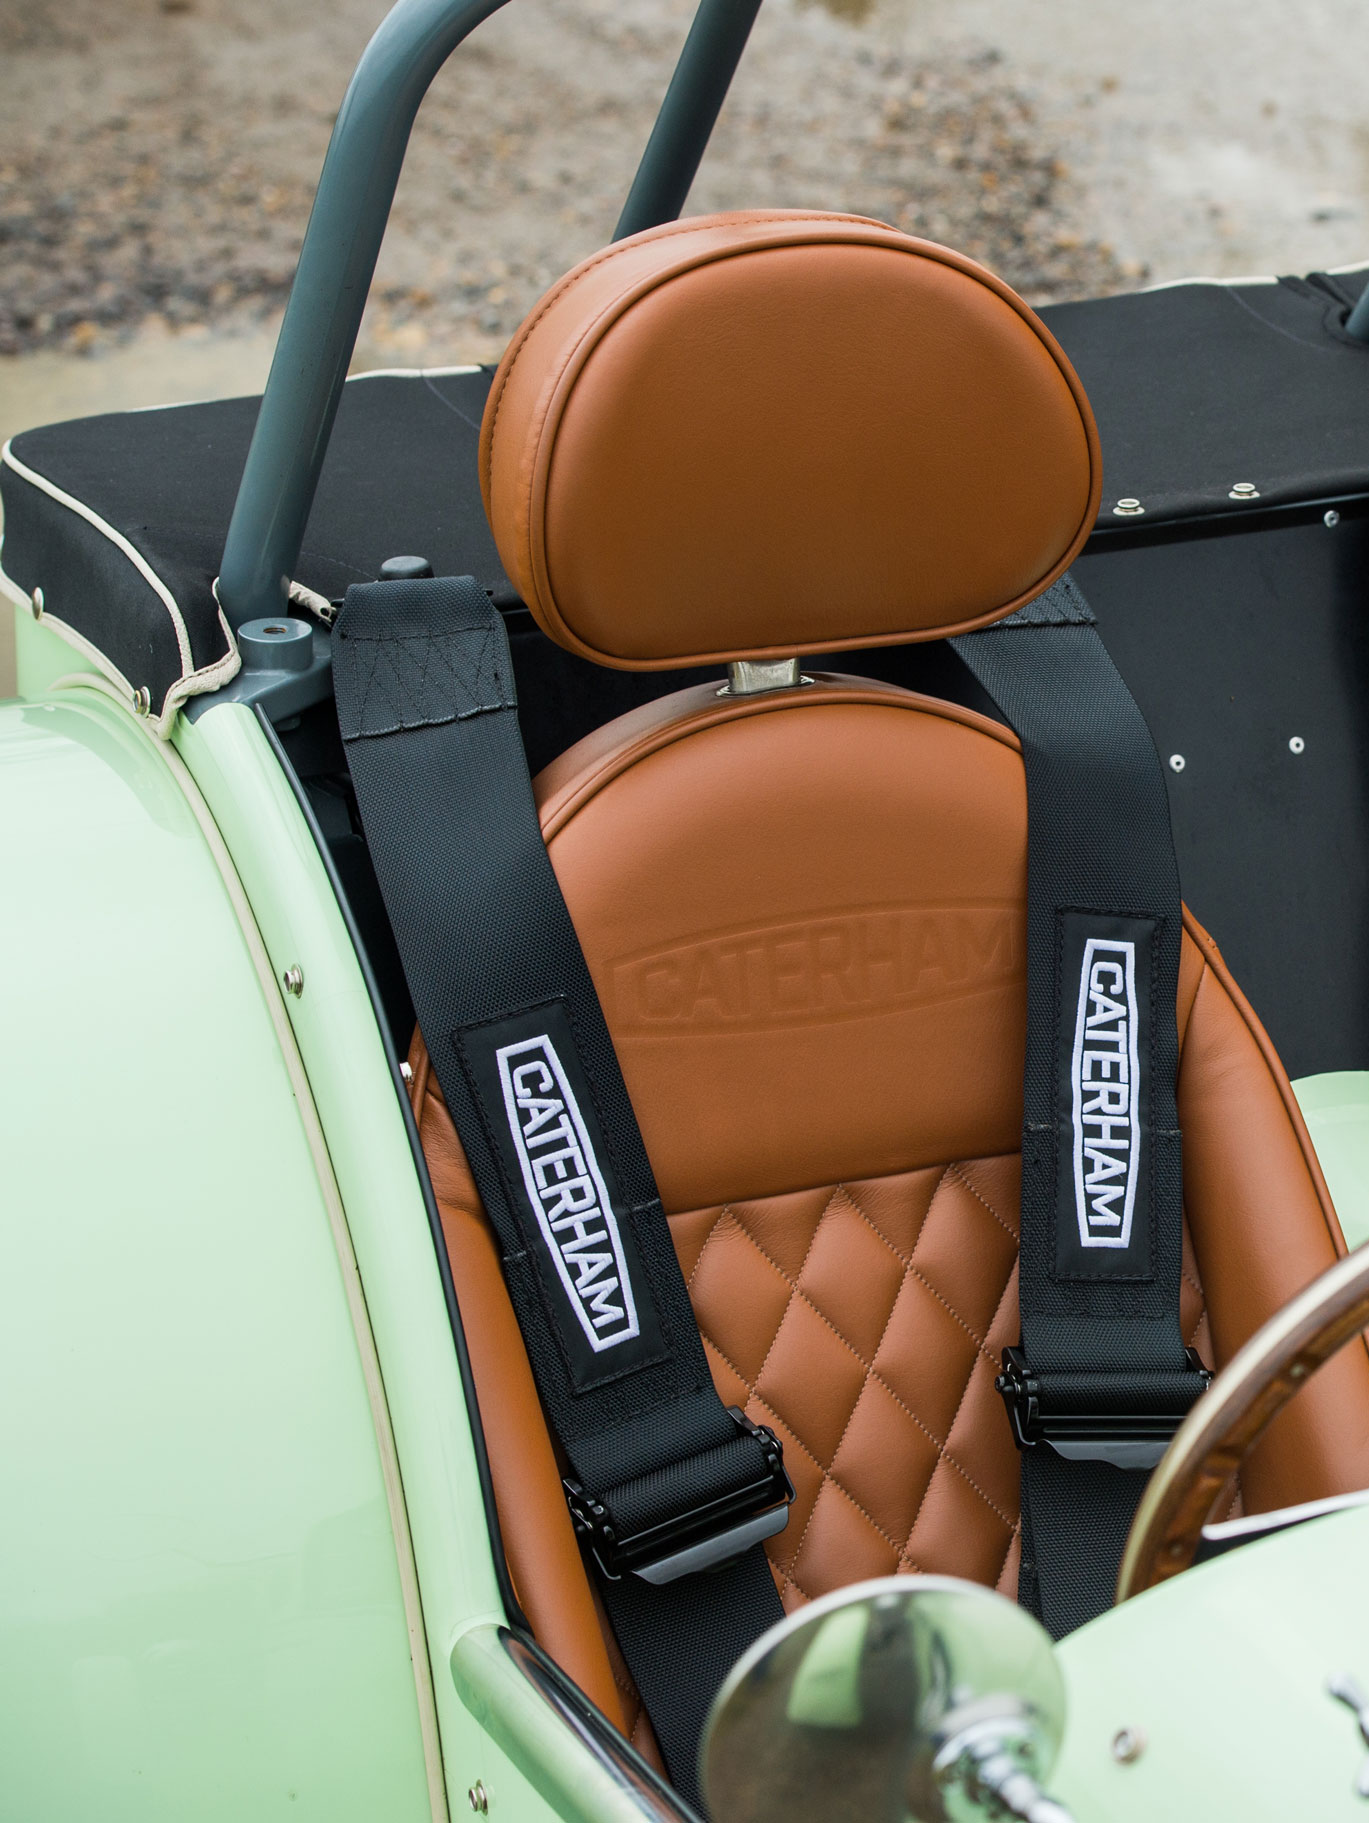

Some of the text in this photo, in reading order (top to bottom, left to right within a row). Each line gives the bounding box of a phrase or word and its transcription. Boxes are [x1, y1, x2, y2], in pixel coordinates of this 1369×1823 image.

[637, 914, 1016, 1020] CATERHAM
[1082, 961, 1130, 1226] CATERHAM
[512, 1061, 625, 1329] CATERHAM
